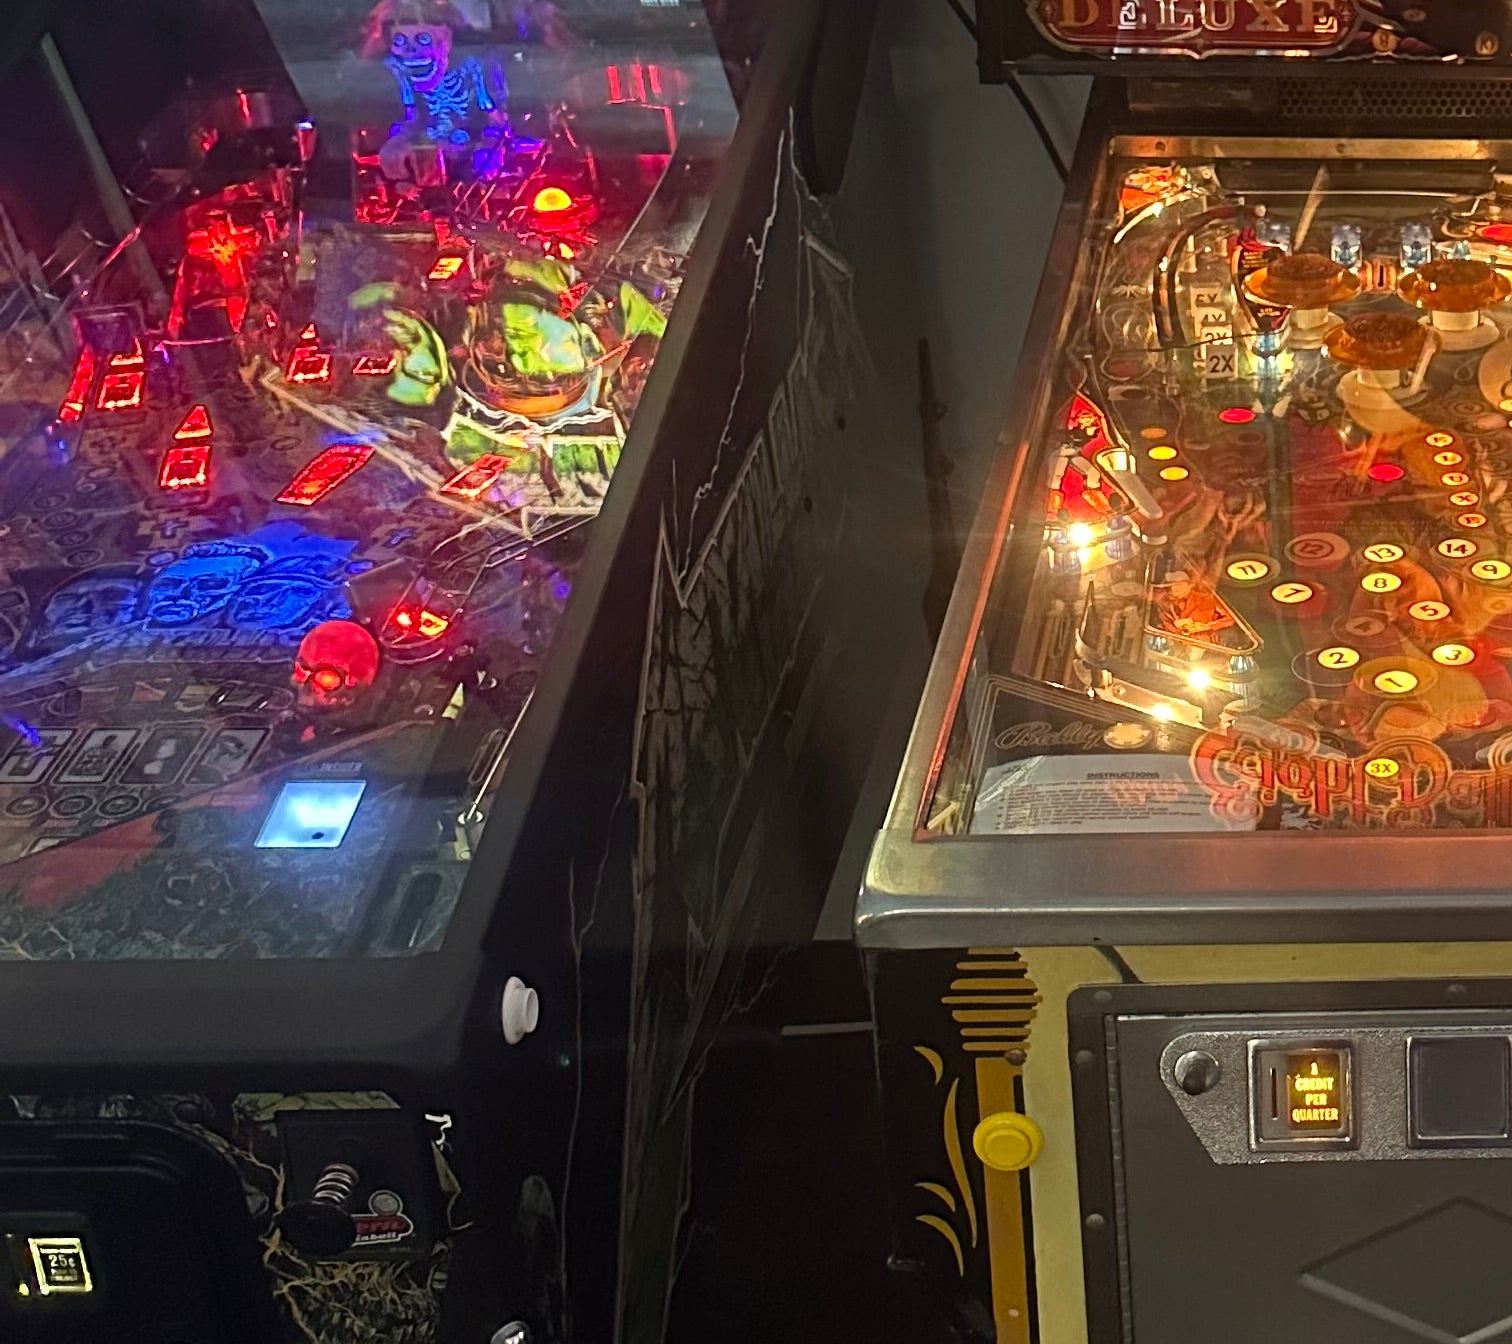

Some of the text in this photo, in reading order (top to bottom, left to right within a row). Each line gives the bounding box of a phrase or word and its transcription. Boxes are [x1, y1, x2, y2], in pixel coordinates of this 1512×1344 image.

[1209, 355, 1234, 374] 2X
[994, 721, 1103, 751] Bally
[1086, 771, 1161, 779] INSTRUCTIONS
[1369, 761, 1393, 776] 3X
[1305, 1092, 1328, 1106] PER
[1291, 1107, 1339, 1123] QUARTER
